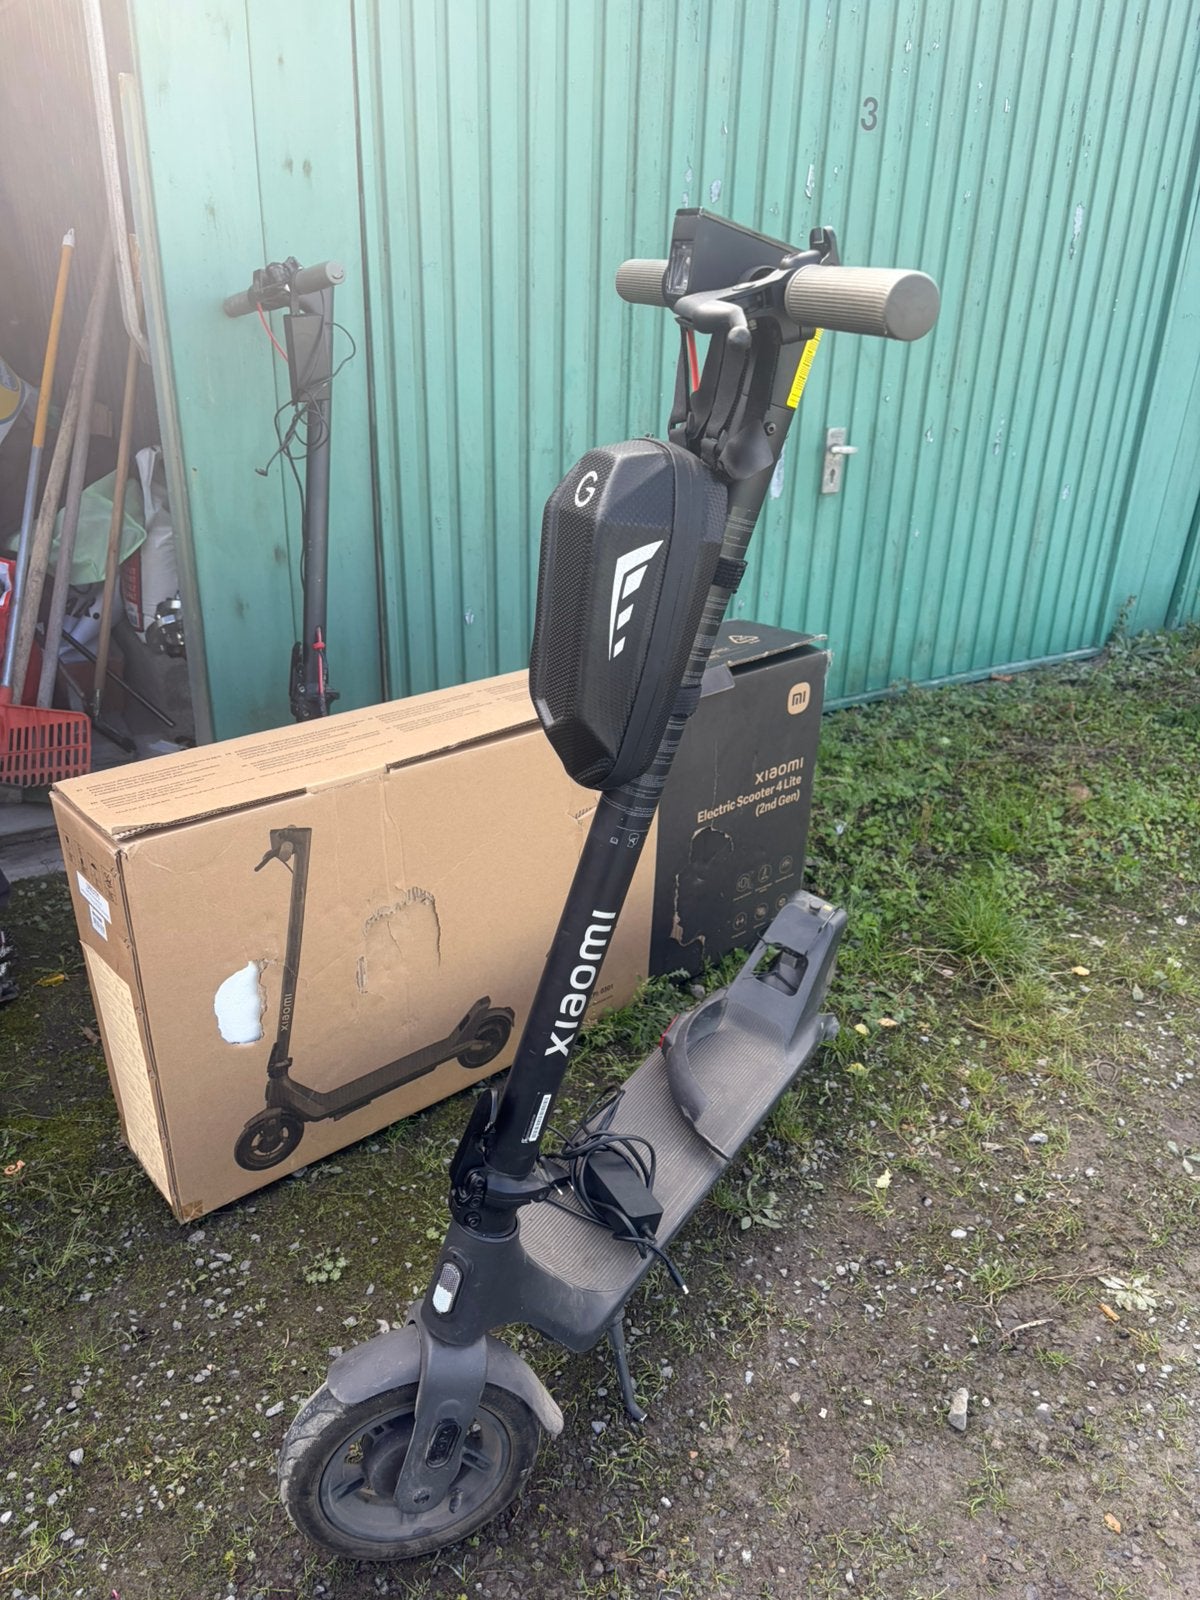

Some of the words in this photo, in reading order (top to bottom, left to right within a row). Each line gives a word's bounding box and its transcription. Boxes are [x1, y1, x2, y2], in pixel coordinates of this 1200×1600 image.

[861, 96, 878, 131] 3
[574, 470, 598, 508] G
[697, 800, 736, 823] Electric
[736, 785, 775, 808] Scooter
[775, 780, 783, 791] 4
[783, 775, 802, 790] Lite
[755, 798, 777, 818] (2nd
[778, 789, 801, 806] Gen)
